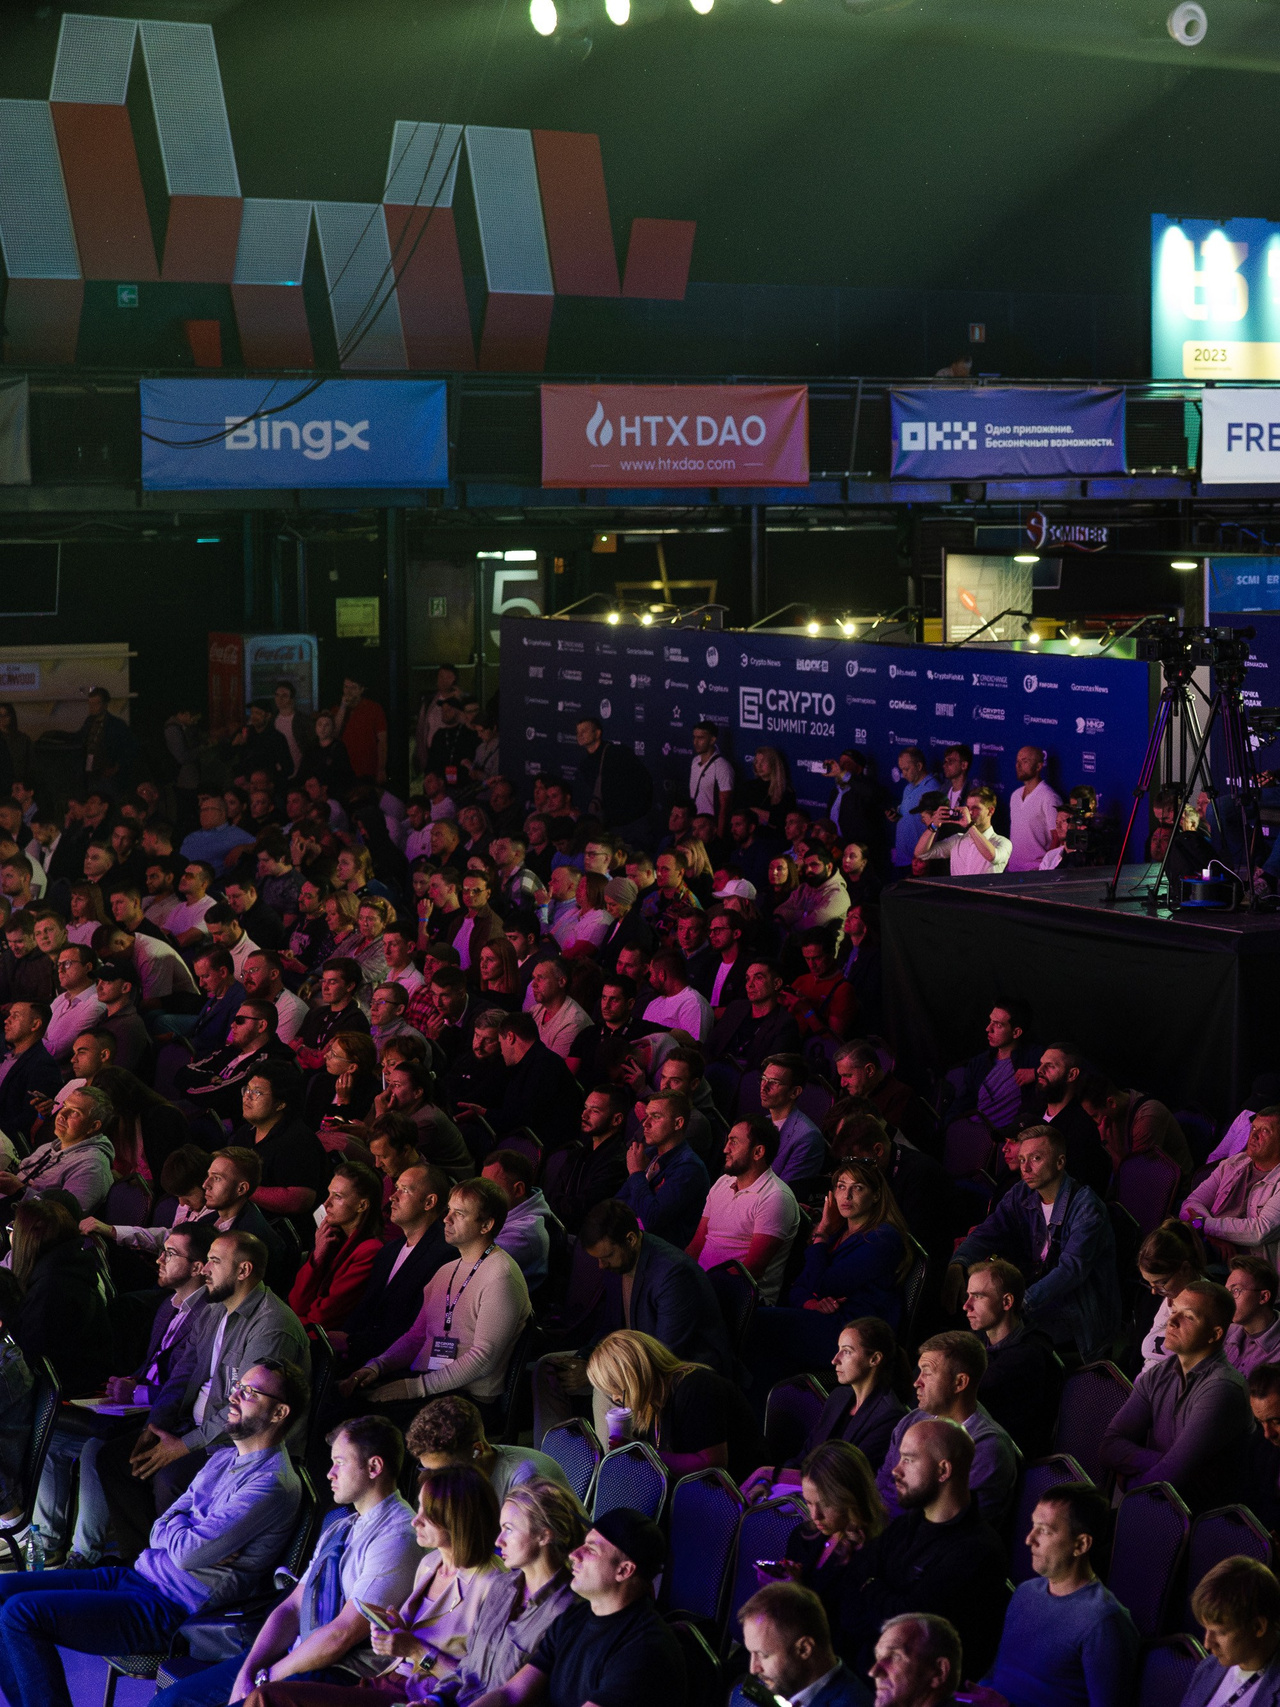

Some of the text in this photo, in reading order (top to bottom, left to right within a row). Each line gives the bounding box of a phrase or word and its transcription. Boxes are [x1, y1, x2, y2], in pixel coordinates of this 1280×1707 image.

[1194, 349, 1228, 362] 2023
[620, 415, 766, 447] HTX DAO
[985, 424, 1074, 436] Одно приложение.
[985, 437, 1114, 448] Бесконечные возможности.
[620, 458, 736, 471] www.htxdao.com
[765, 689, 836, 716] CRYPTO
[766, 717, 836, 737] SUMMIT 2024
